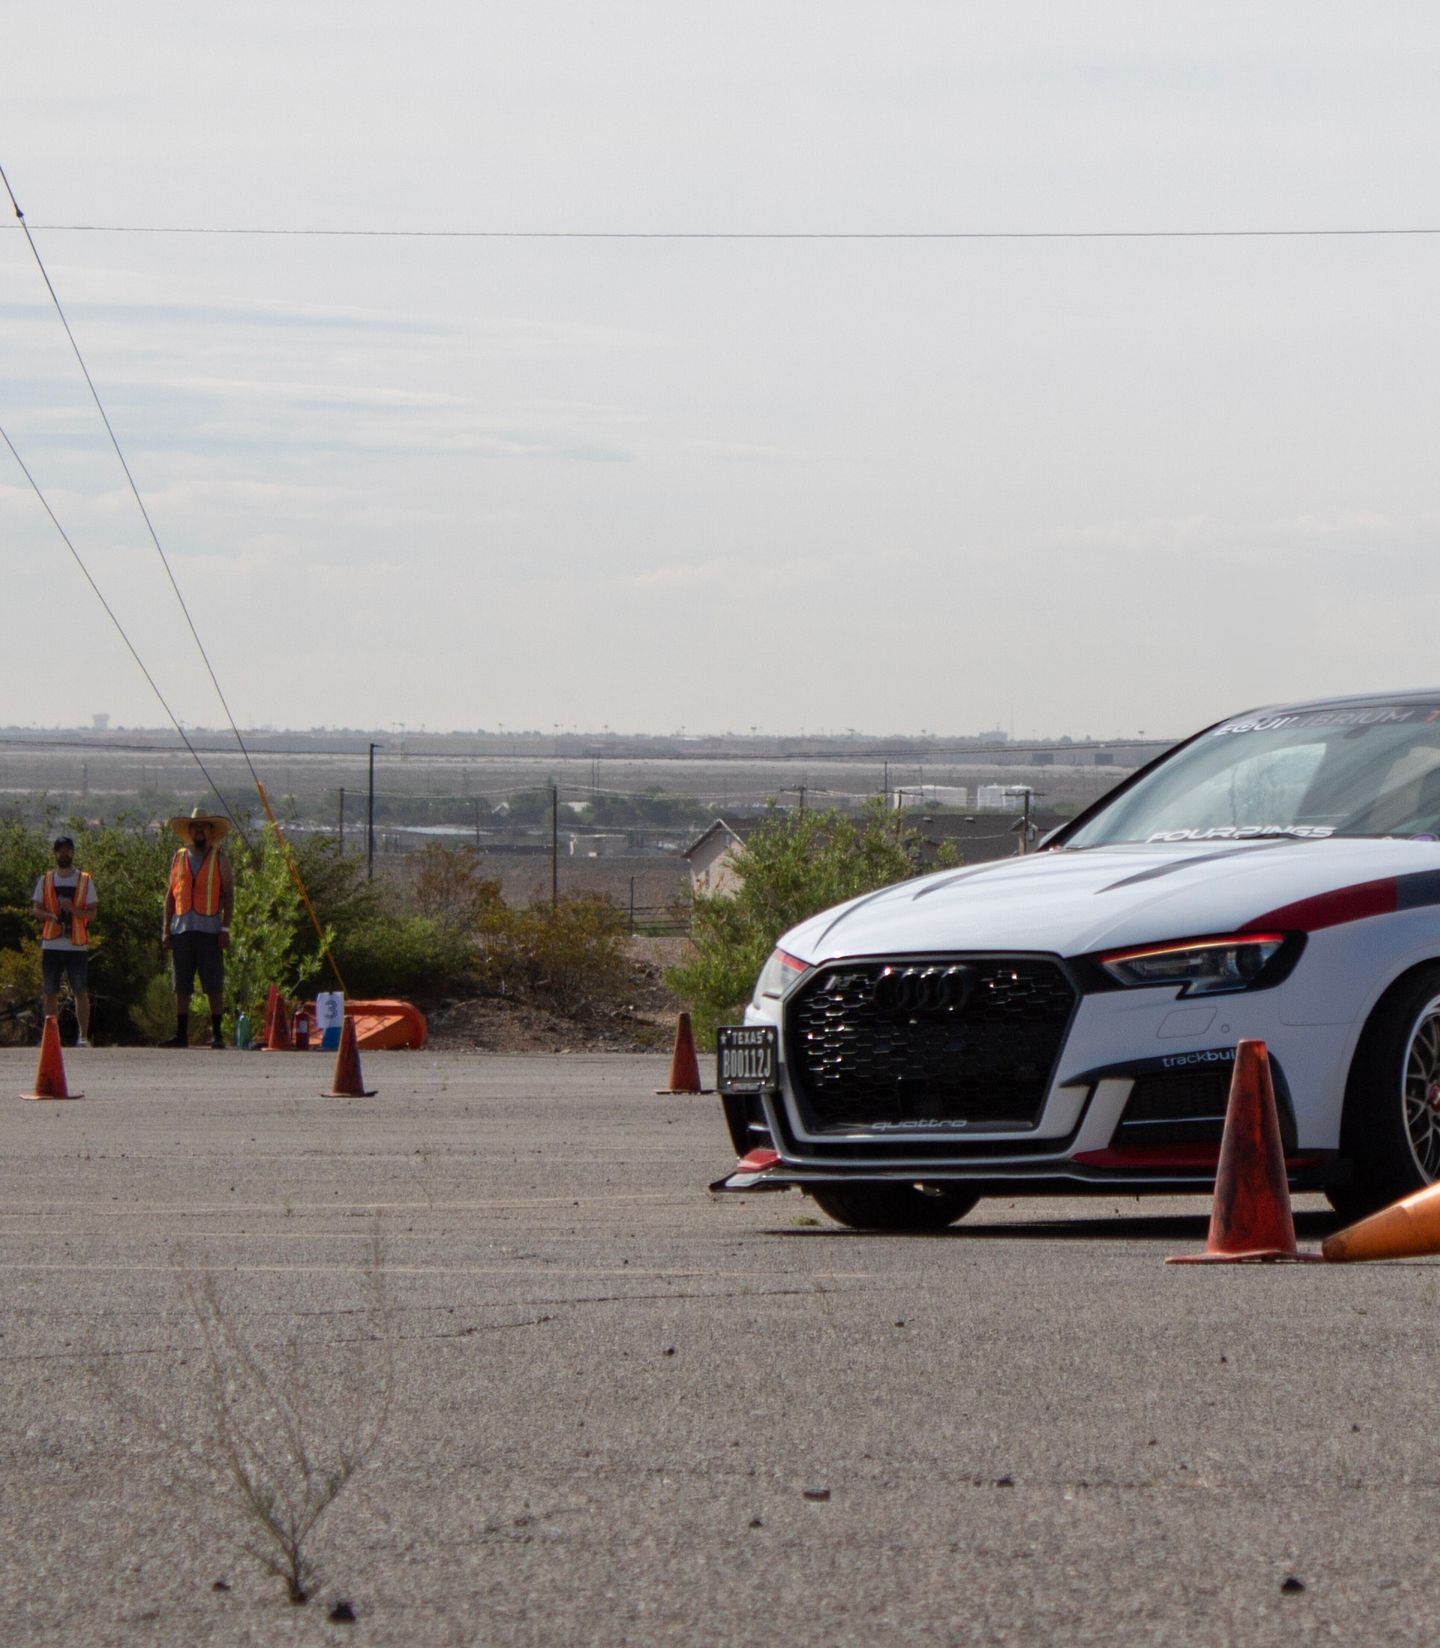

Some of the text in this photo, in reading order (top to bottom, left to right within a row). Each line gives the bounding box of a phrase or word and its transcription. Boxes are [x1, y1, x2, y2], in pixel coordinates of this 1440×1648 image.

[324, 1000, 337, 1019] 3
[732, 1031, 762, 1045] TEXAS
[1162, 1048, 1236, 1067] trackbui
[872, 1119, 967, 1131] quattro
